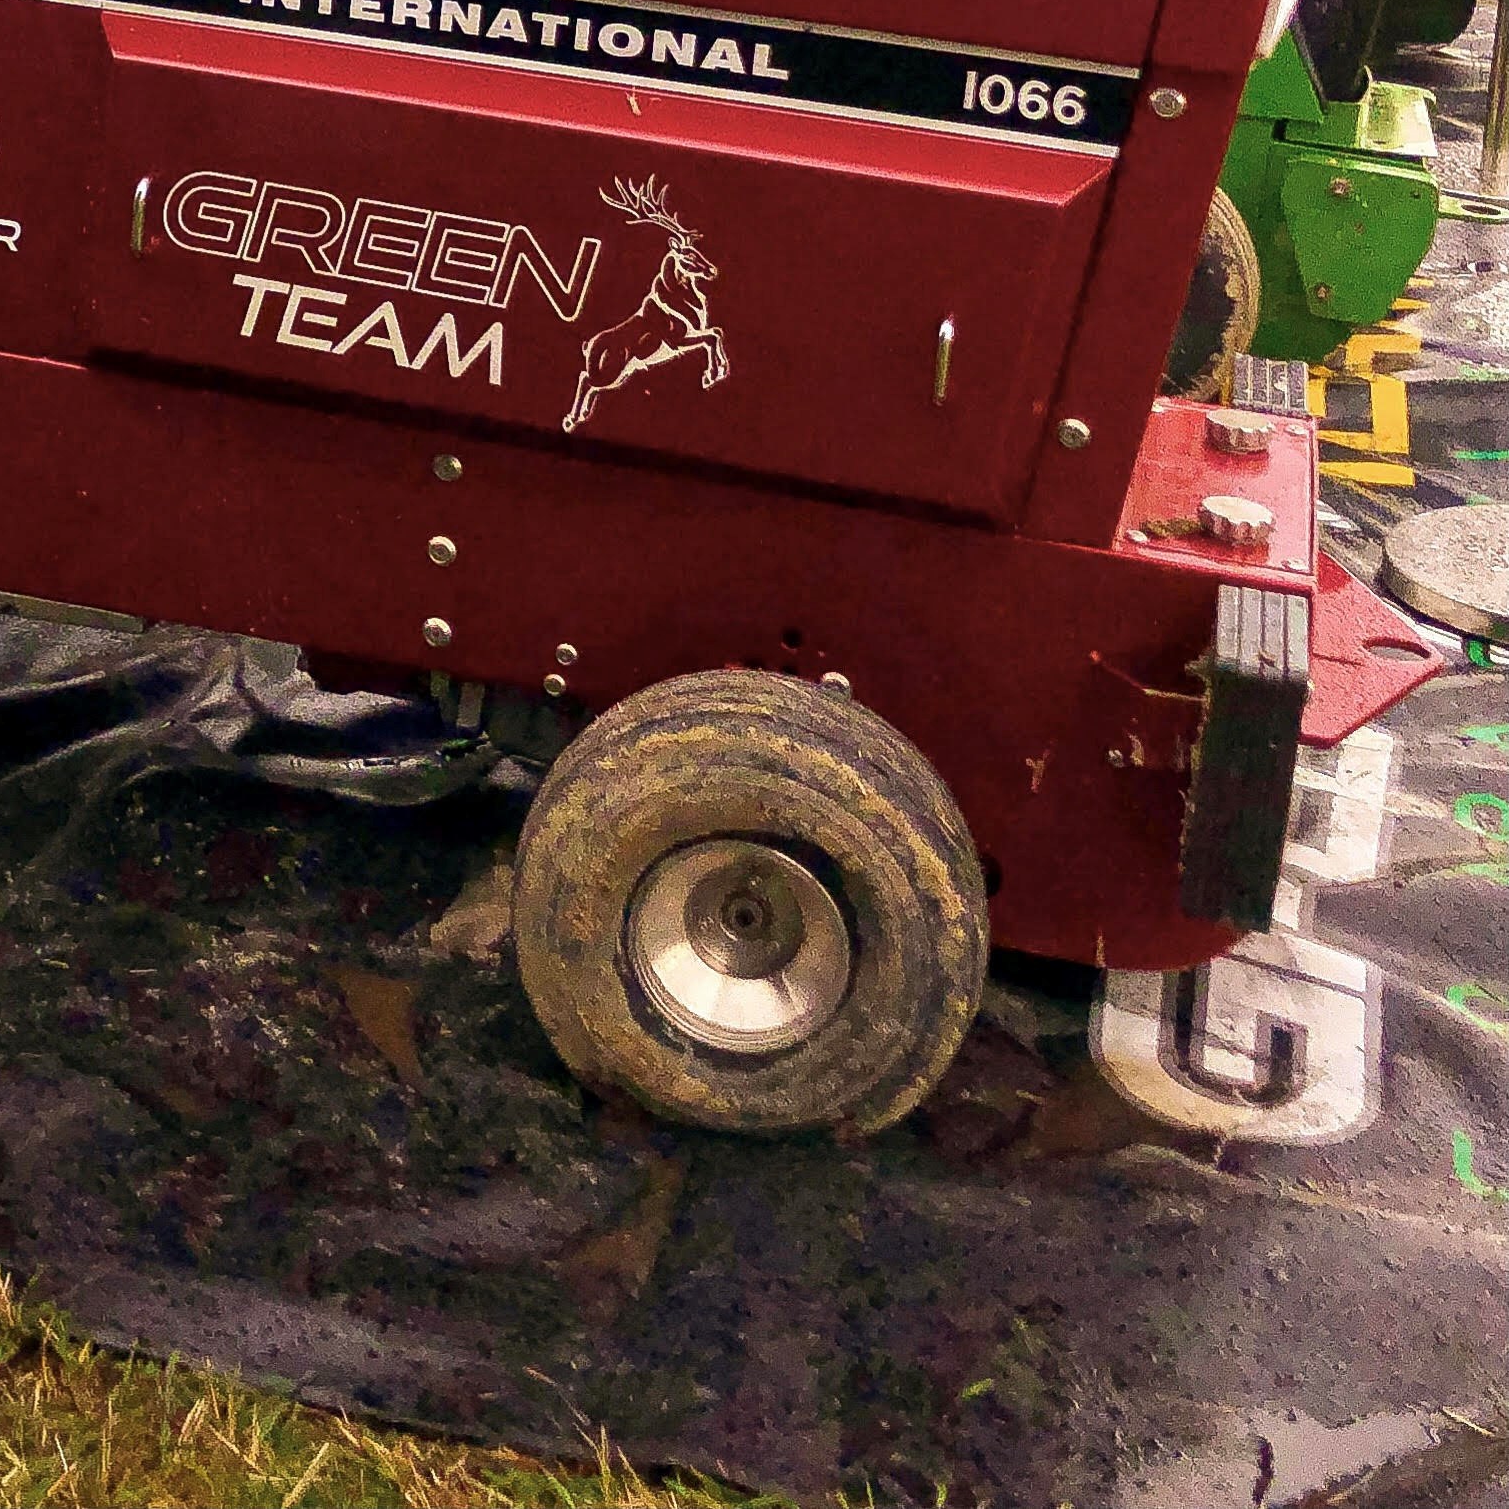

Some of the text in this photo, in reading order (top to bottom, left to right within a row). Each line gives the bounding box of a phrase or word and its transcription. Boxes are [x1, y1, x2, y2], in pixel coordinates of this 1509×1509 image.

[963, 70, 1088, 127] 1066
[163, 170, 601, 323] GREEN
[232, 273, 503, 386] TEAM
